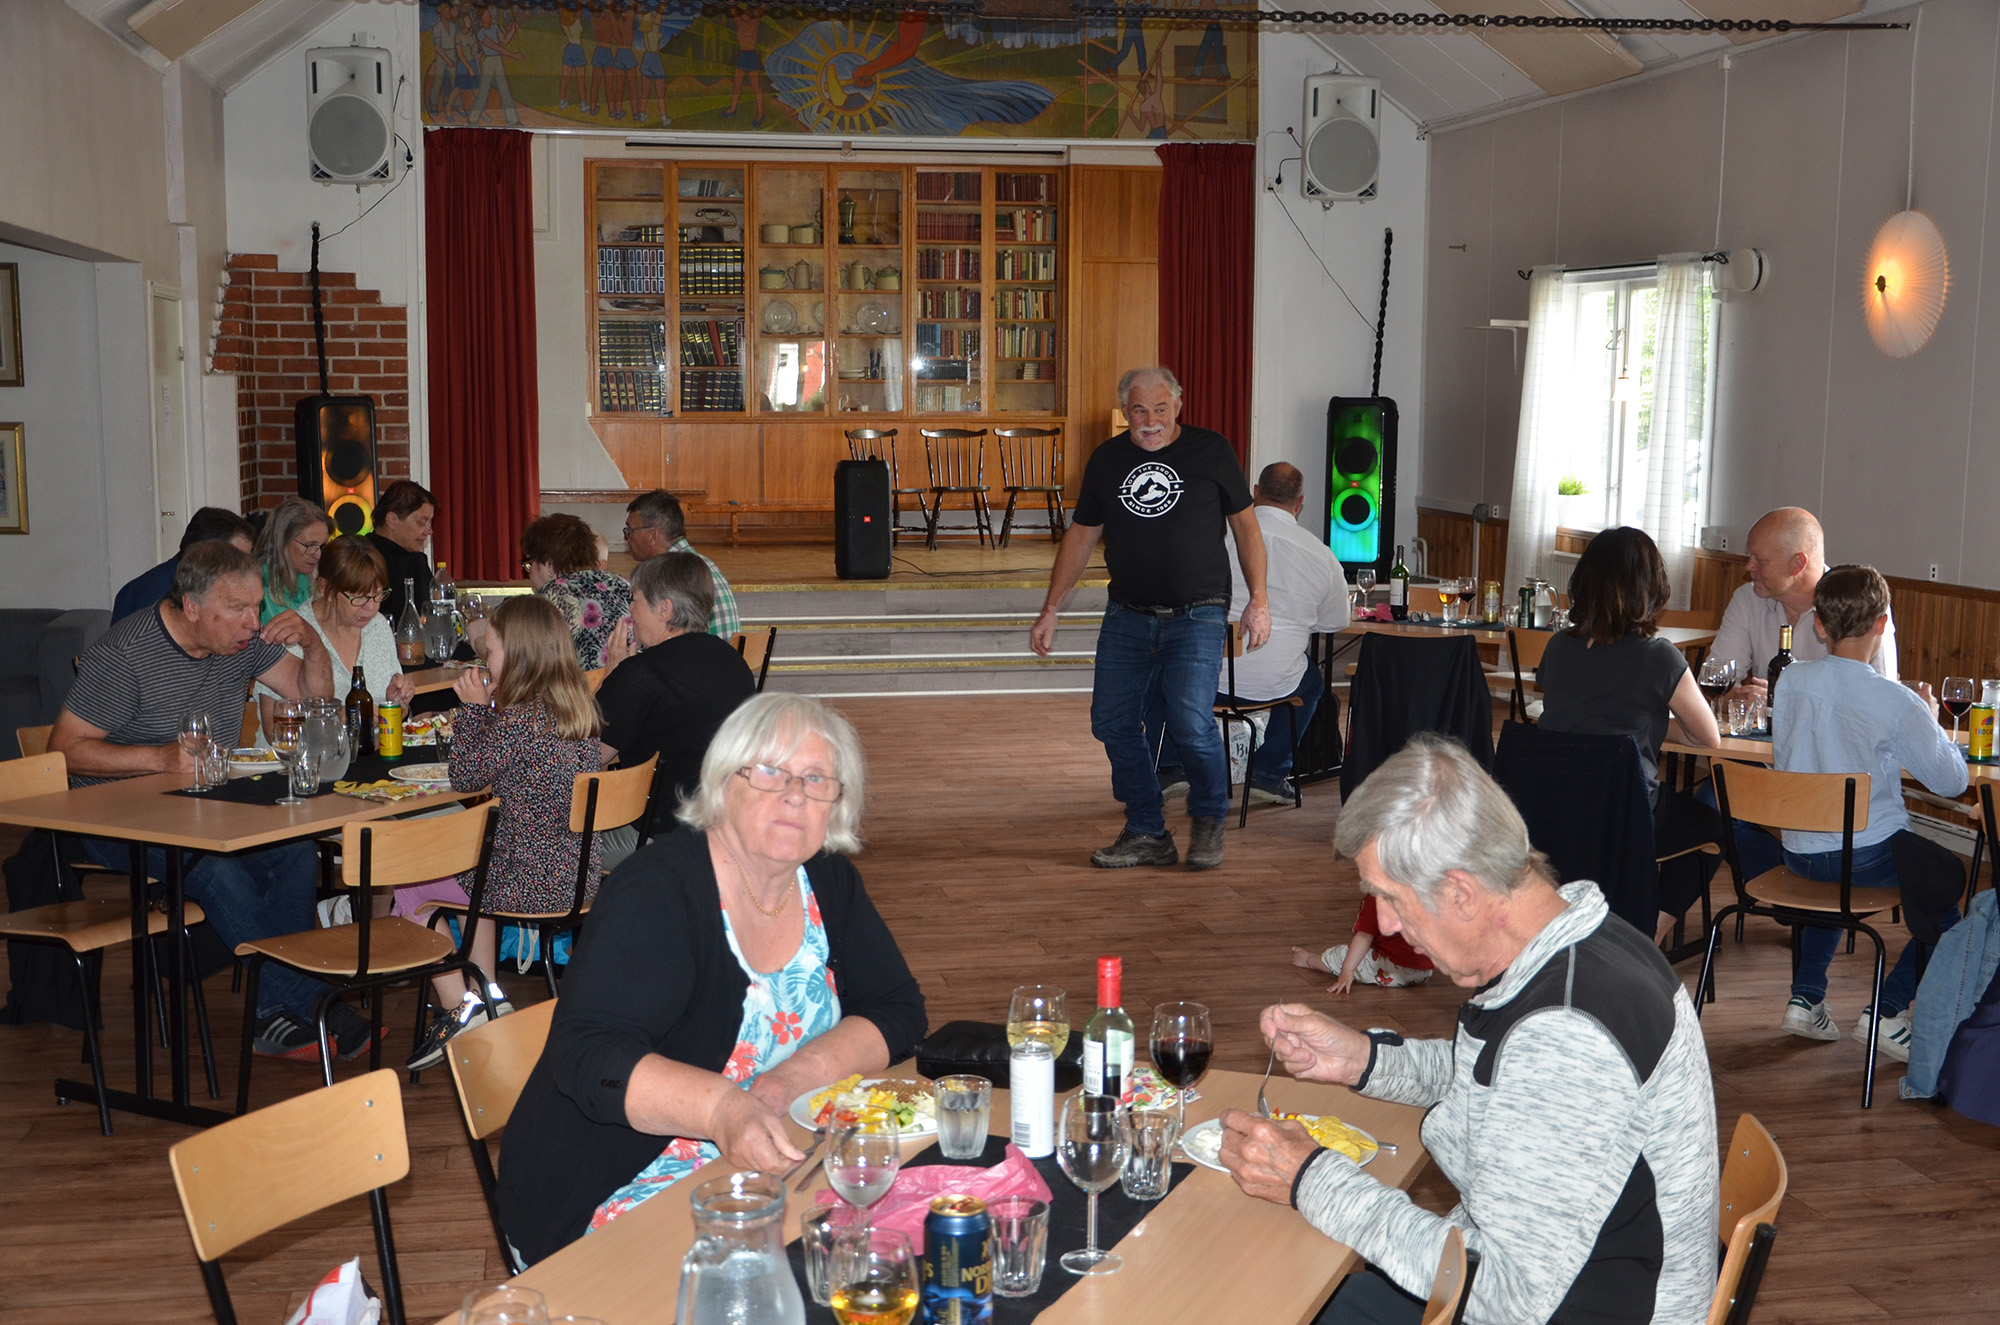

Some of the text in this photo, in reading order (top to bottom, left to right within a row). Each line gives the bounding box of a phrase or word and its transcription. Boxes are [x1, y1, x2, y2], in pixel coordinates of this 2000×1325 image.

[1127, 474, 1137, 485] ON
[1138, 465, 1152, 473] THE
[1155, 466, 1174, 480] SNOW
[1128, 500, 1151, 513] SINCE
